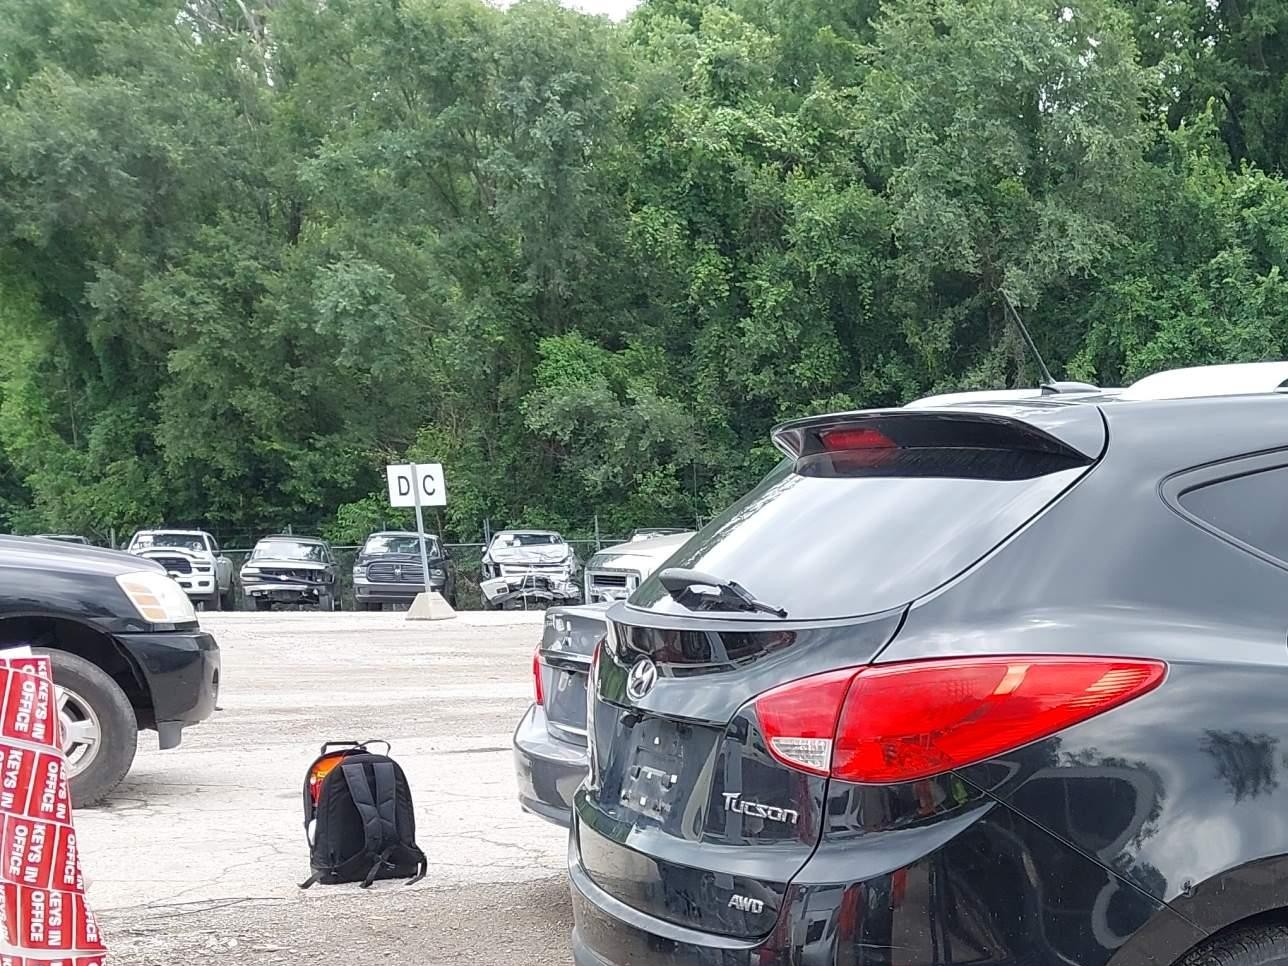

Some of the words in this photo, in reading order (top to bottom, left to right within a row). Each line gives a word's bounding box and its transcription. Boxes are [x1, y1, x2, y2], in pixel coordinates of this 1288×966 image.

[397, 475, 410, 496] D
[422, 474, 436, 496] C
[14, 680, 36, 733] OFFICE
[35, 680, 49, 720] KEYS
[31, 722, 46, 740] IN
[3, 749, 24, 789] KEYS
[40, 761, 59, 813] OFFICE
[0, 791, 15, 809] IN
[55, 802, 67, 820] IN
[722, 792, 799, 825] Tucson
[8, 825, 29, 876] OFFICE
[27, 823, 46, 864] KEYS
[63, 833, 76, 885] OFFICE
[23, 866, 39, 883] IN
[30, 890, 45, 942] OFFICE
[727, 894, 765, 914] AWD
[47, 929, 62, 947] IN
